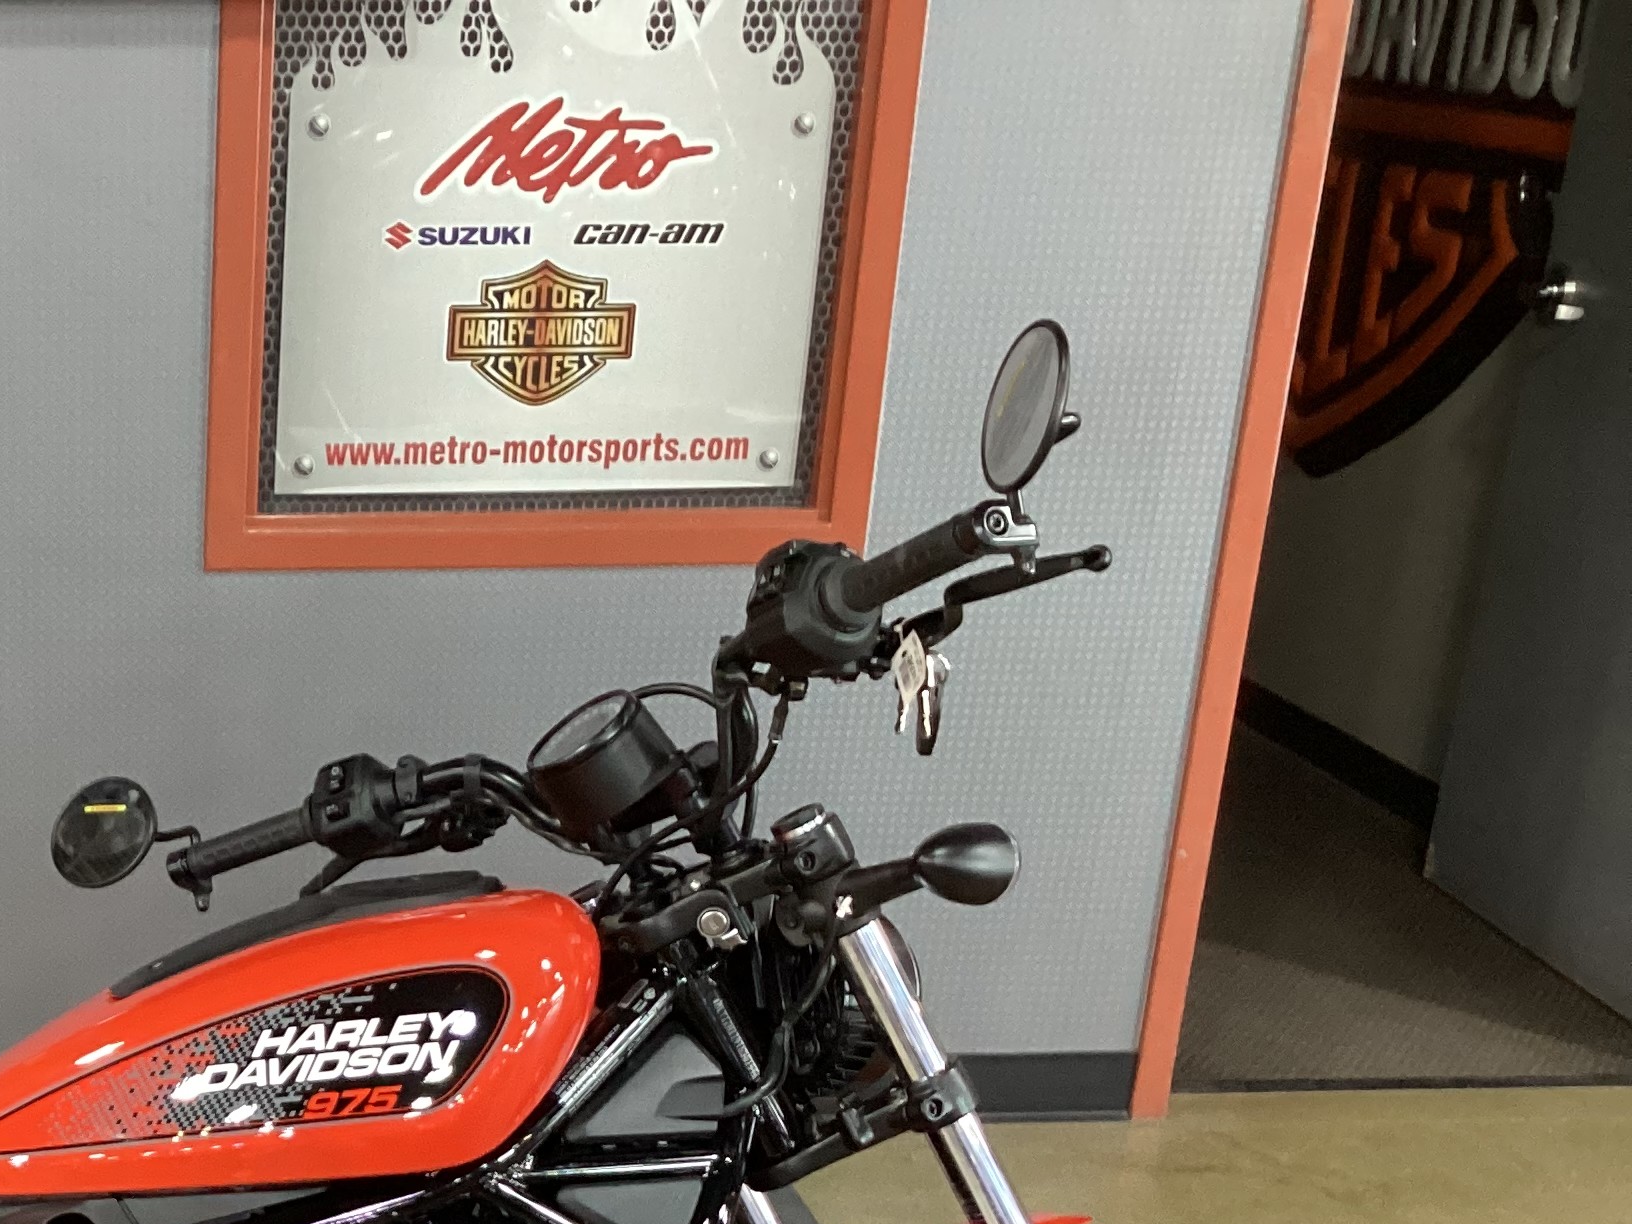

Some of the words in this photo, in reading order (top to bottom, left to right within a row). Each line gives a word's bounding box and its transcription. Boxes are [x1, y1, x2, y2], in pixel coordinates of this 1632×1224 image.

[420, 97, 713, 203] Metro
[418, 227, 530, 245] SUZUKI
[574, 223, 724, 244] can-am
[502, 276, 585, 309] MOTOR
[463, 317, 621, 347] HARLEY-DAVIDSON
[498, 355, 578, 391] CYCLES
[325, 433, 749, 469] www.metro-motorsports.com
[251, 1011, 466, 1057] HARLEY
[201, 1041, 460, 1092] DAVIDSON
[302, 1084, 403, 1118] 975
